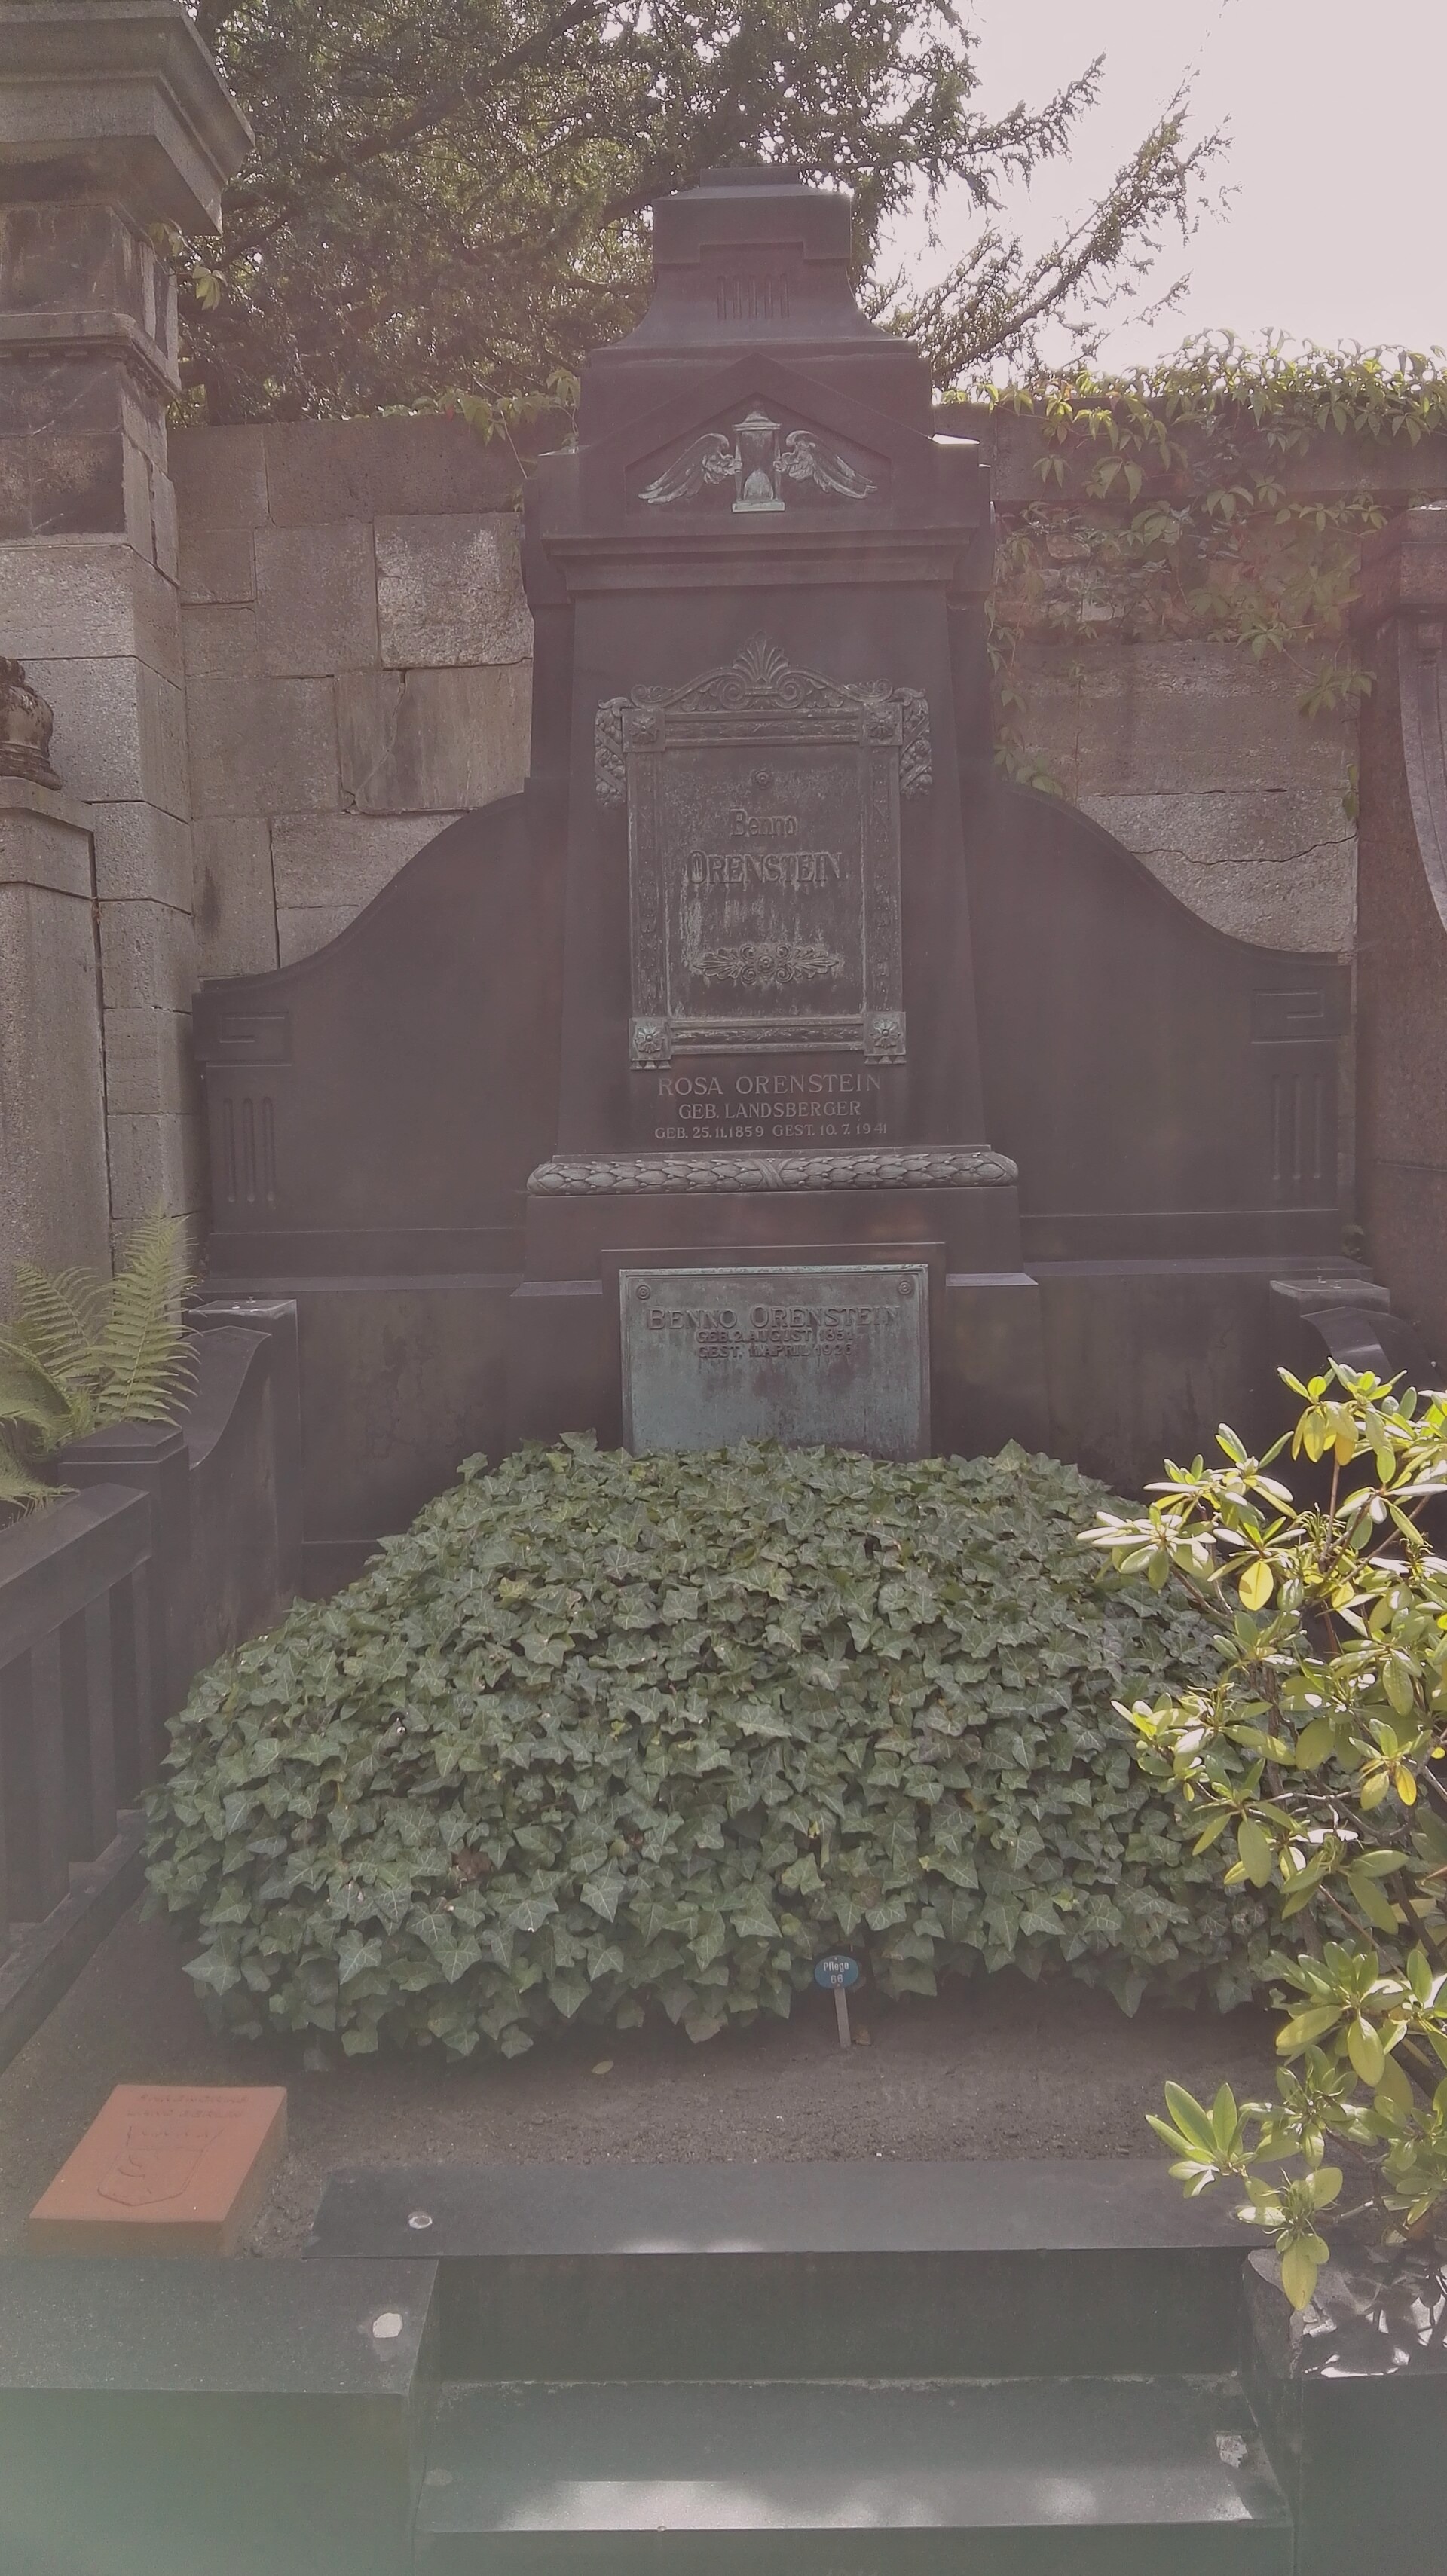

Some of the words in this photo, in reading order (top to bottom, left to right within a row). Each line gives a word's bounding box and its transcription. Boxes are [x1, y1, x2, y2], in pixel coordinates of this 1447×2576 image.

[729, 808, 798, 836] Benno
[686, 850, 842, 883] ORENSTEIN
[659, 1077, 724, 1096] ROSA
[735, 1074, 881, 1095] ORENSTEIN
[678, 1104, 720, 1120] GEB.
[725, 1101, 861, 1119] LANDSBERGER
[654, 1127, 688, 1139] GEB.
[772, 1124, 815, 1137] GEST.
[647, 1308, 737, 1330] BENNO
[750, 1303, 900, 1328] ORENSTEIN
[823, 1961, 849, 1972] Pflege
